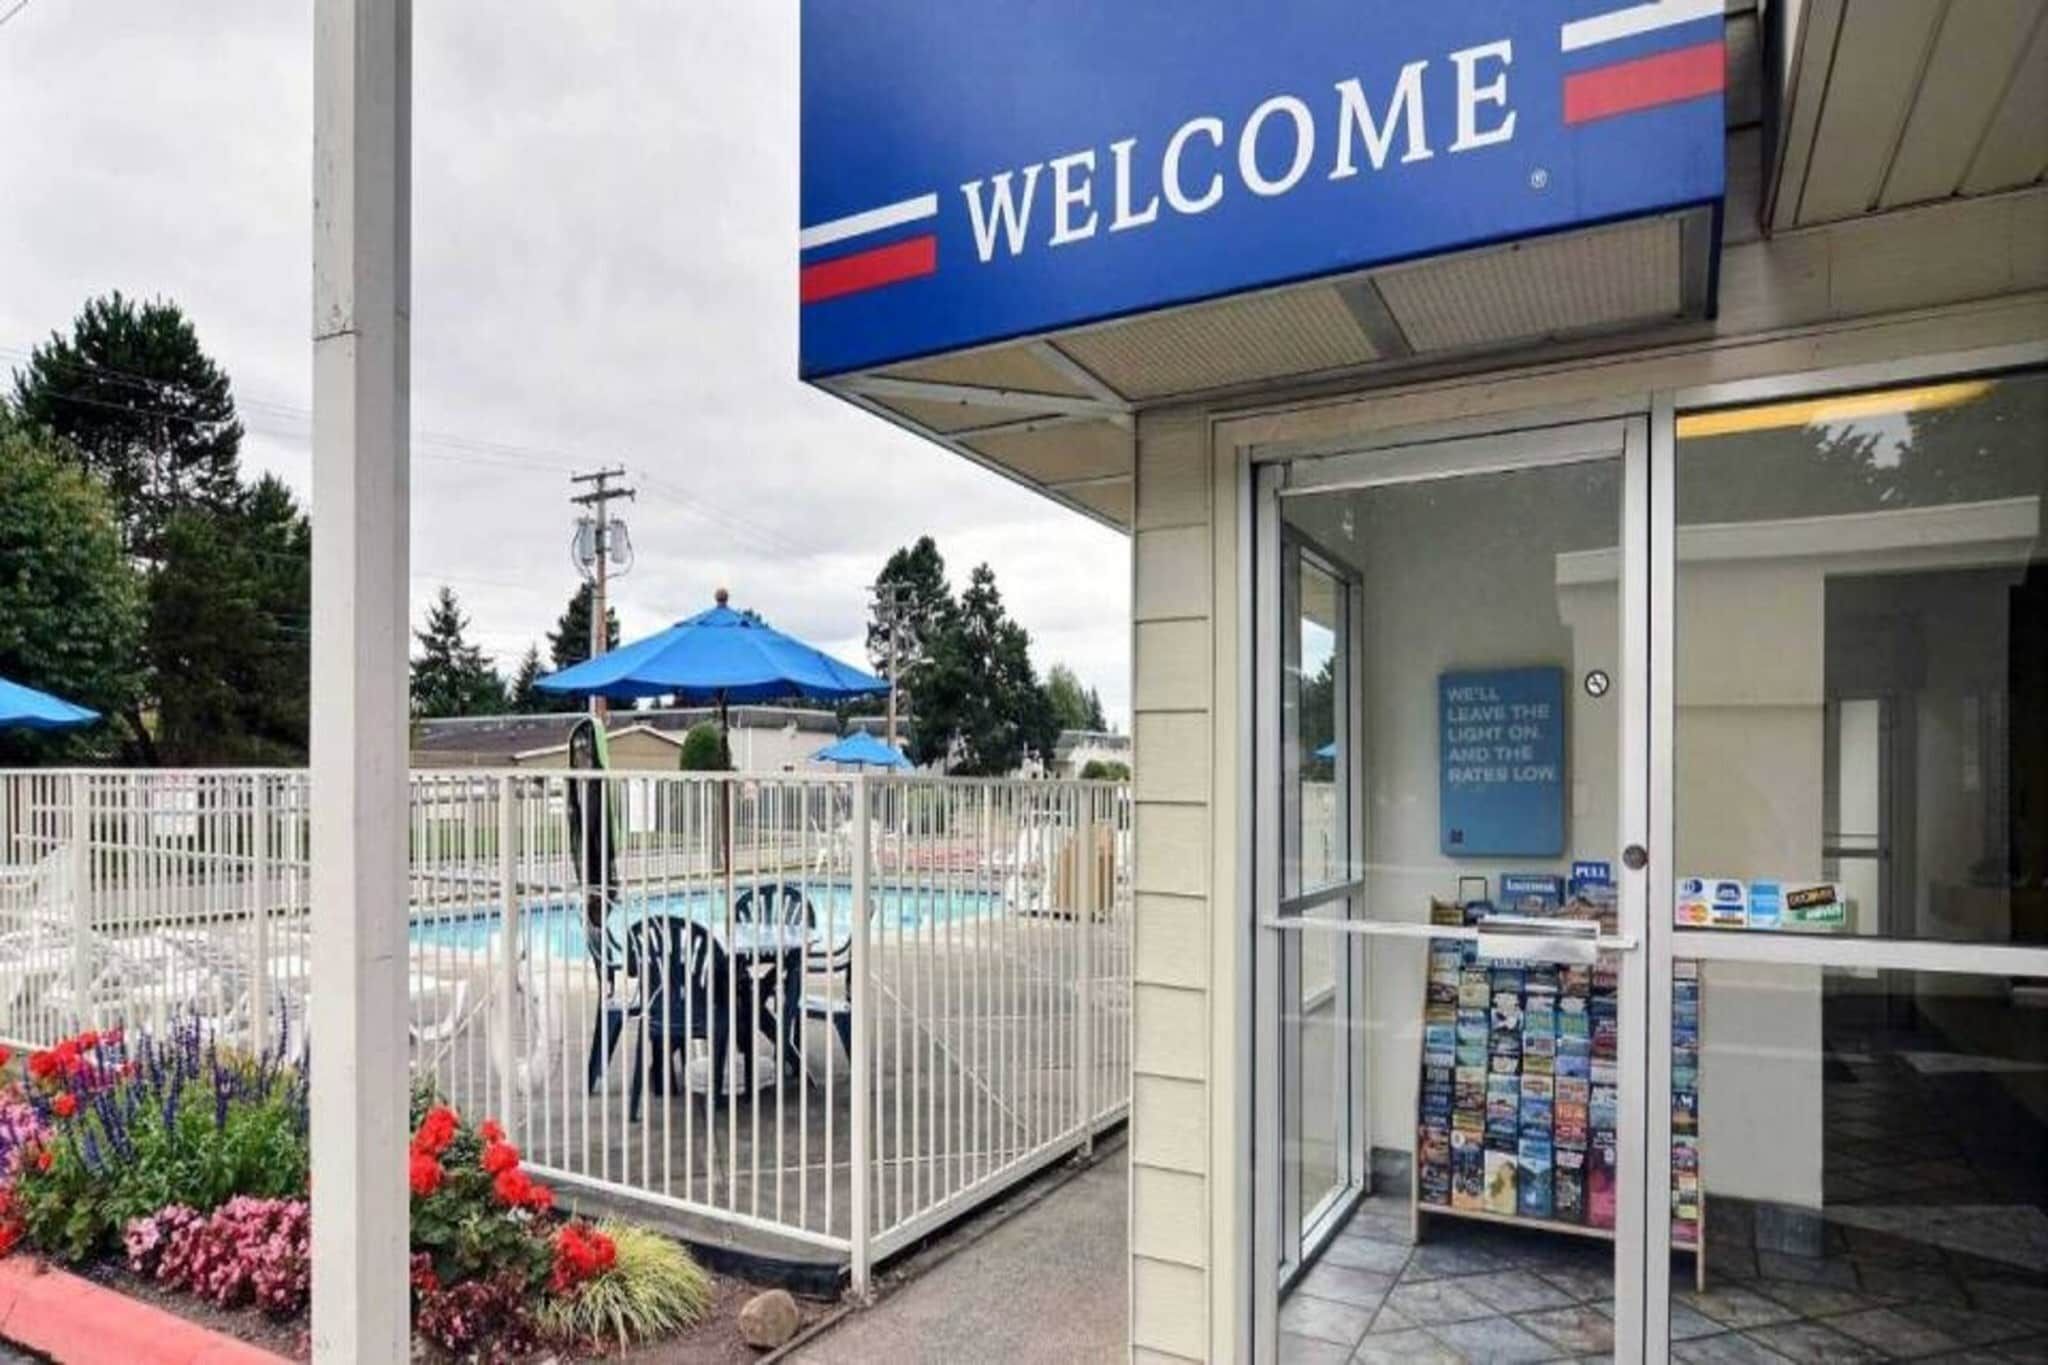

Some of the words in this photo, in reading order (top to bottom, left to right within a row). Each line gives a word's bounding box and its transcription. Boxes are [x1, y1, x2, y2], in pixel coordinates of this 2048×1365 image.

[960, 39, 1517, 263] WELCOME
[1448, 705, 1505, 722] LEAVE
[1511, 703, 1552, 719] THE
[1448, 726, 1502, 742] LIGHT
[1448, 747, 1489, 763] AND
[1494, 746, 1533, 761] THE
[1448, 767, 1508, 783] RATES
